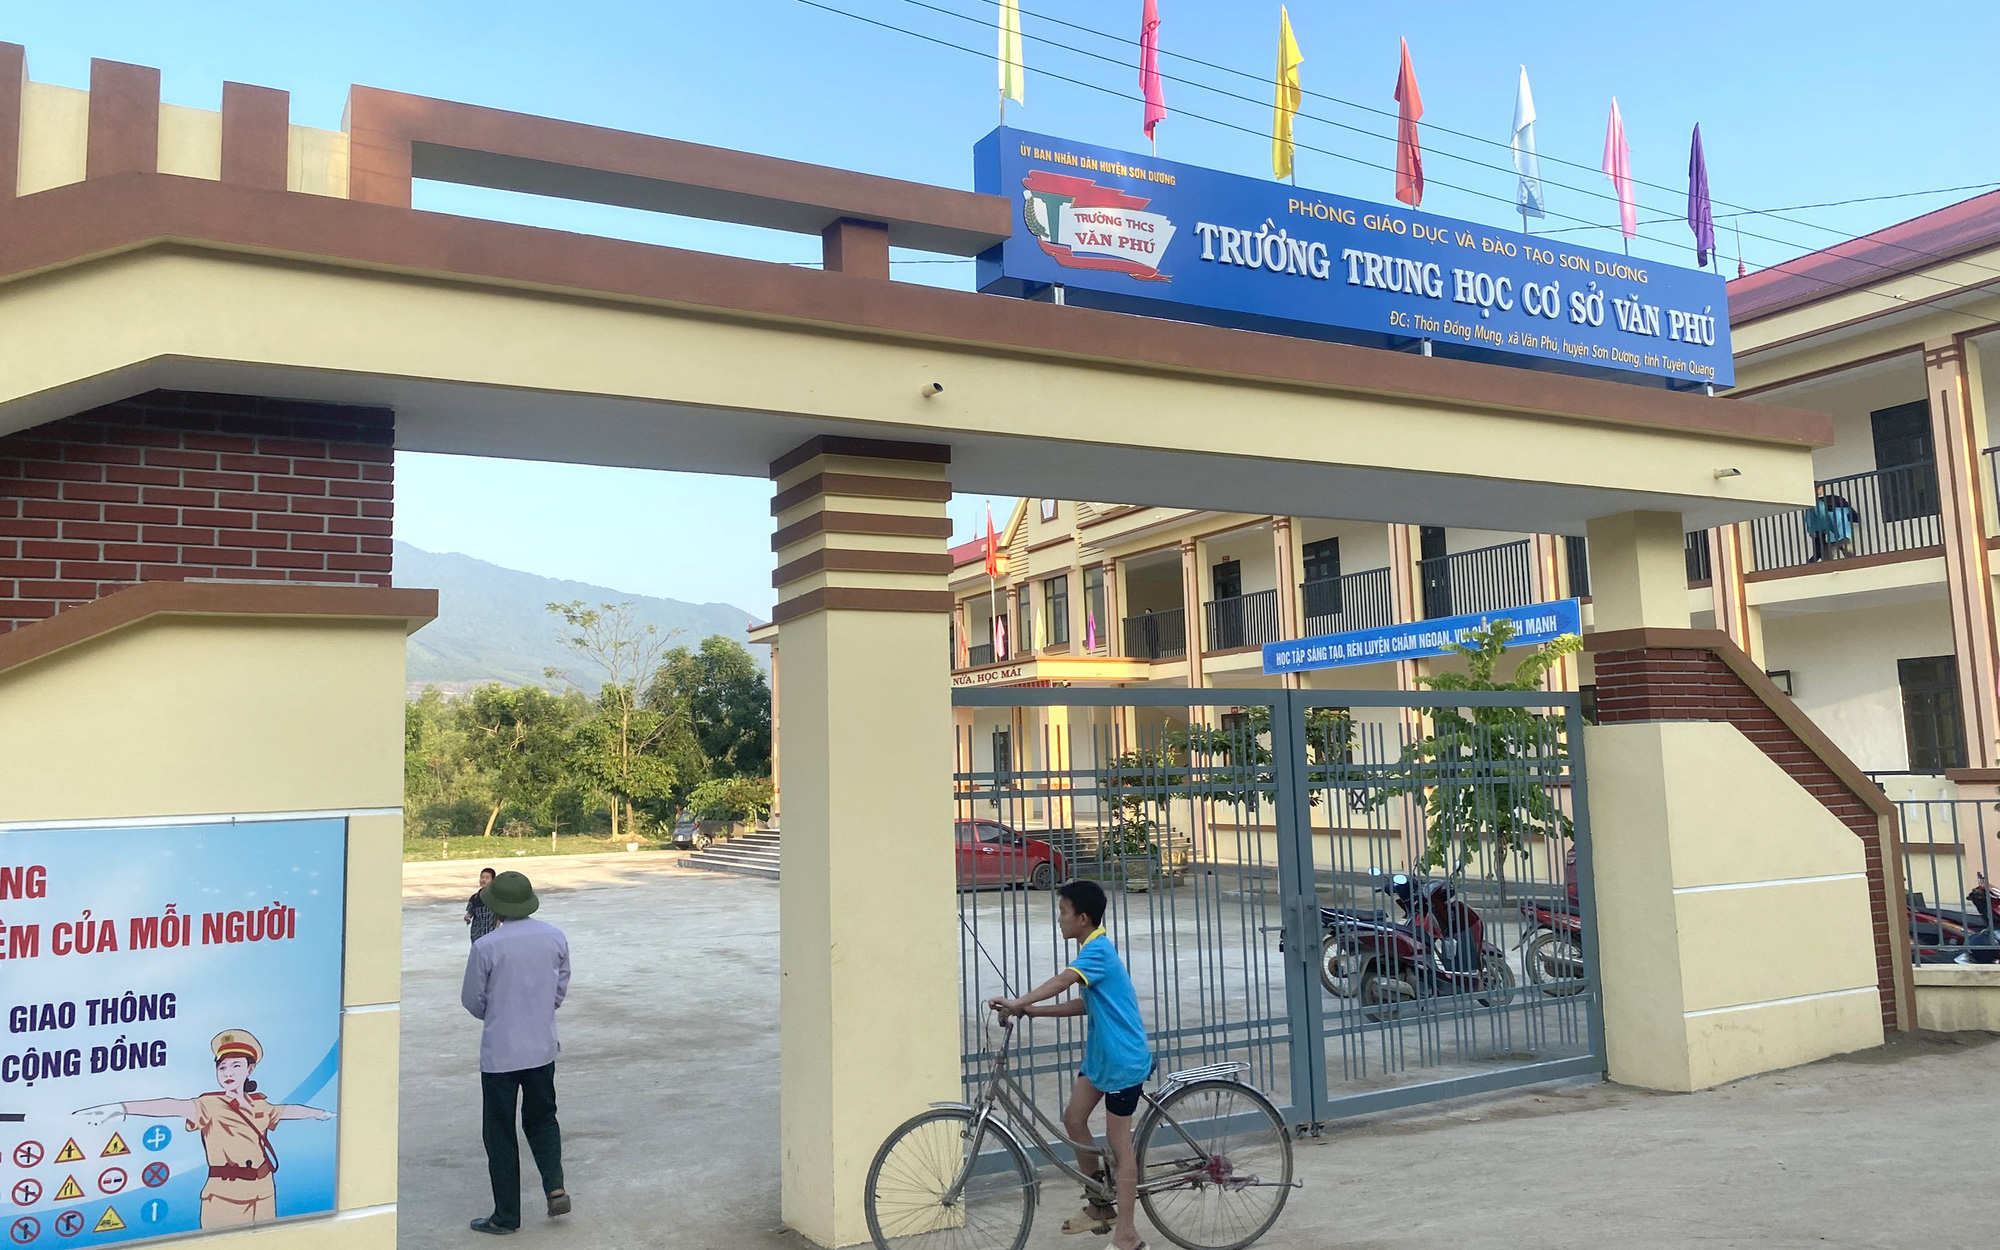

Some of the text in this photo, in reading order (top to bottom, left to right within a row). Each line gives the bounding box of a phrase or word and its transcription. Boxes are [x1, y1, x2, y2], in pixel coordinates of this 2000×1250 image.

[1019, 141, 1176, 187] ỦY BAN NHÂN DÂN HUYỆN SƠN DƯƠNG
[1074, 211, 1155, 234] TRƯỜNG THCS
[1074, 229, 1156, 254] VĂN PHÚ
[1288, 198, 1648, 284] PHÒNG GIÁO DỤC VÀ ĐÀO TẠO SƠN DƯƠNG
[1194, 217, 1716, 348] TRƯỜNG TRUNG HỌC CƠ SỞ VĂN PHÚ
[1389, 311, 1410, 328] ĐC:
[1414, 314, 1440, 333] Thôn
[1474, 324, 1504, 347] Mụng,
[1507, 331, 1519, 345] xã
[1521, 332, 1538, 348] Văn
[1540, 335, 1560, 354] Phú,
[1562, 338, 1589, 359] huyện
[1591, 344, 1609, 361] Sơn
[1611, 347, 1641, 369] Dương,
[1644, 351, 1660, 368] tỉnh
[1662, 355, 1687, 374] Tuyên
[1688, 361, 1715, 381] Quang
[1276, 651, 1290, 668] HỌC
[1292, 647, 1305, 667] TẬP
[1306, 645, 1327, 663] SÁNG
[1328, 644, 1346, 663] TẠO,
[1347, 639, 1363, 658] RÈN
[1364, 636, 1390, 657] LUYỆN
[1391, 632, 1418, 652] CHĂM
[1525, 614, 1558, 638] MẠNH
[977, 671, 998, 684] HỌC
[52, 909, 119, 956] CỦA
[129, 902, 192, 951] MỖI
[201, 900, 296, 946] NGƯỜI
[8, 990, 177, 1034] GIAO THÔNG
[1, 1034, 167, 1087] CỘNG ĐỒNG
